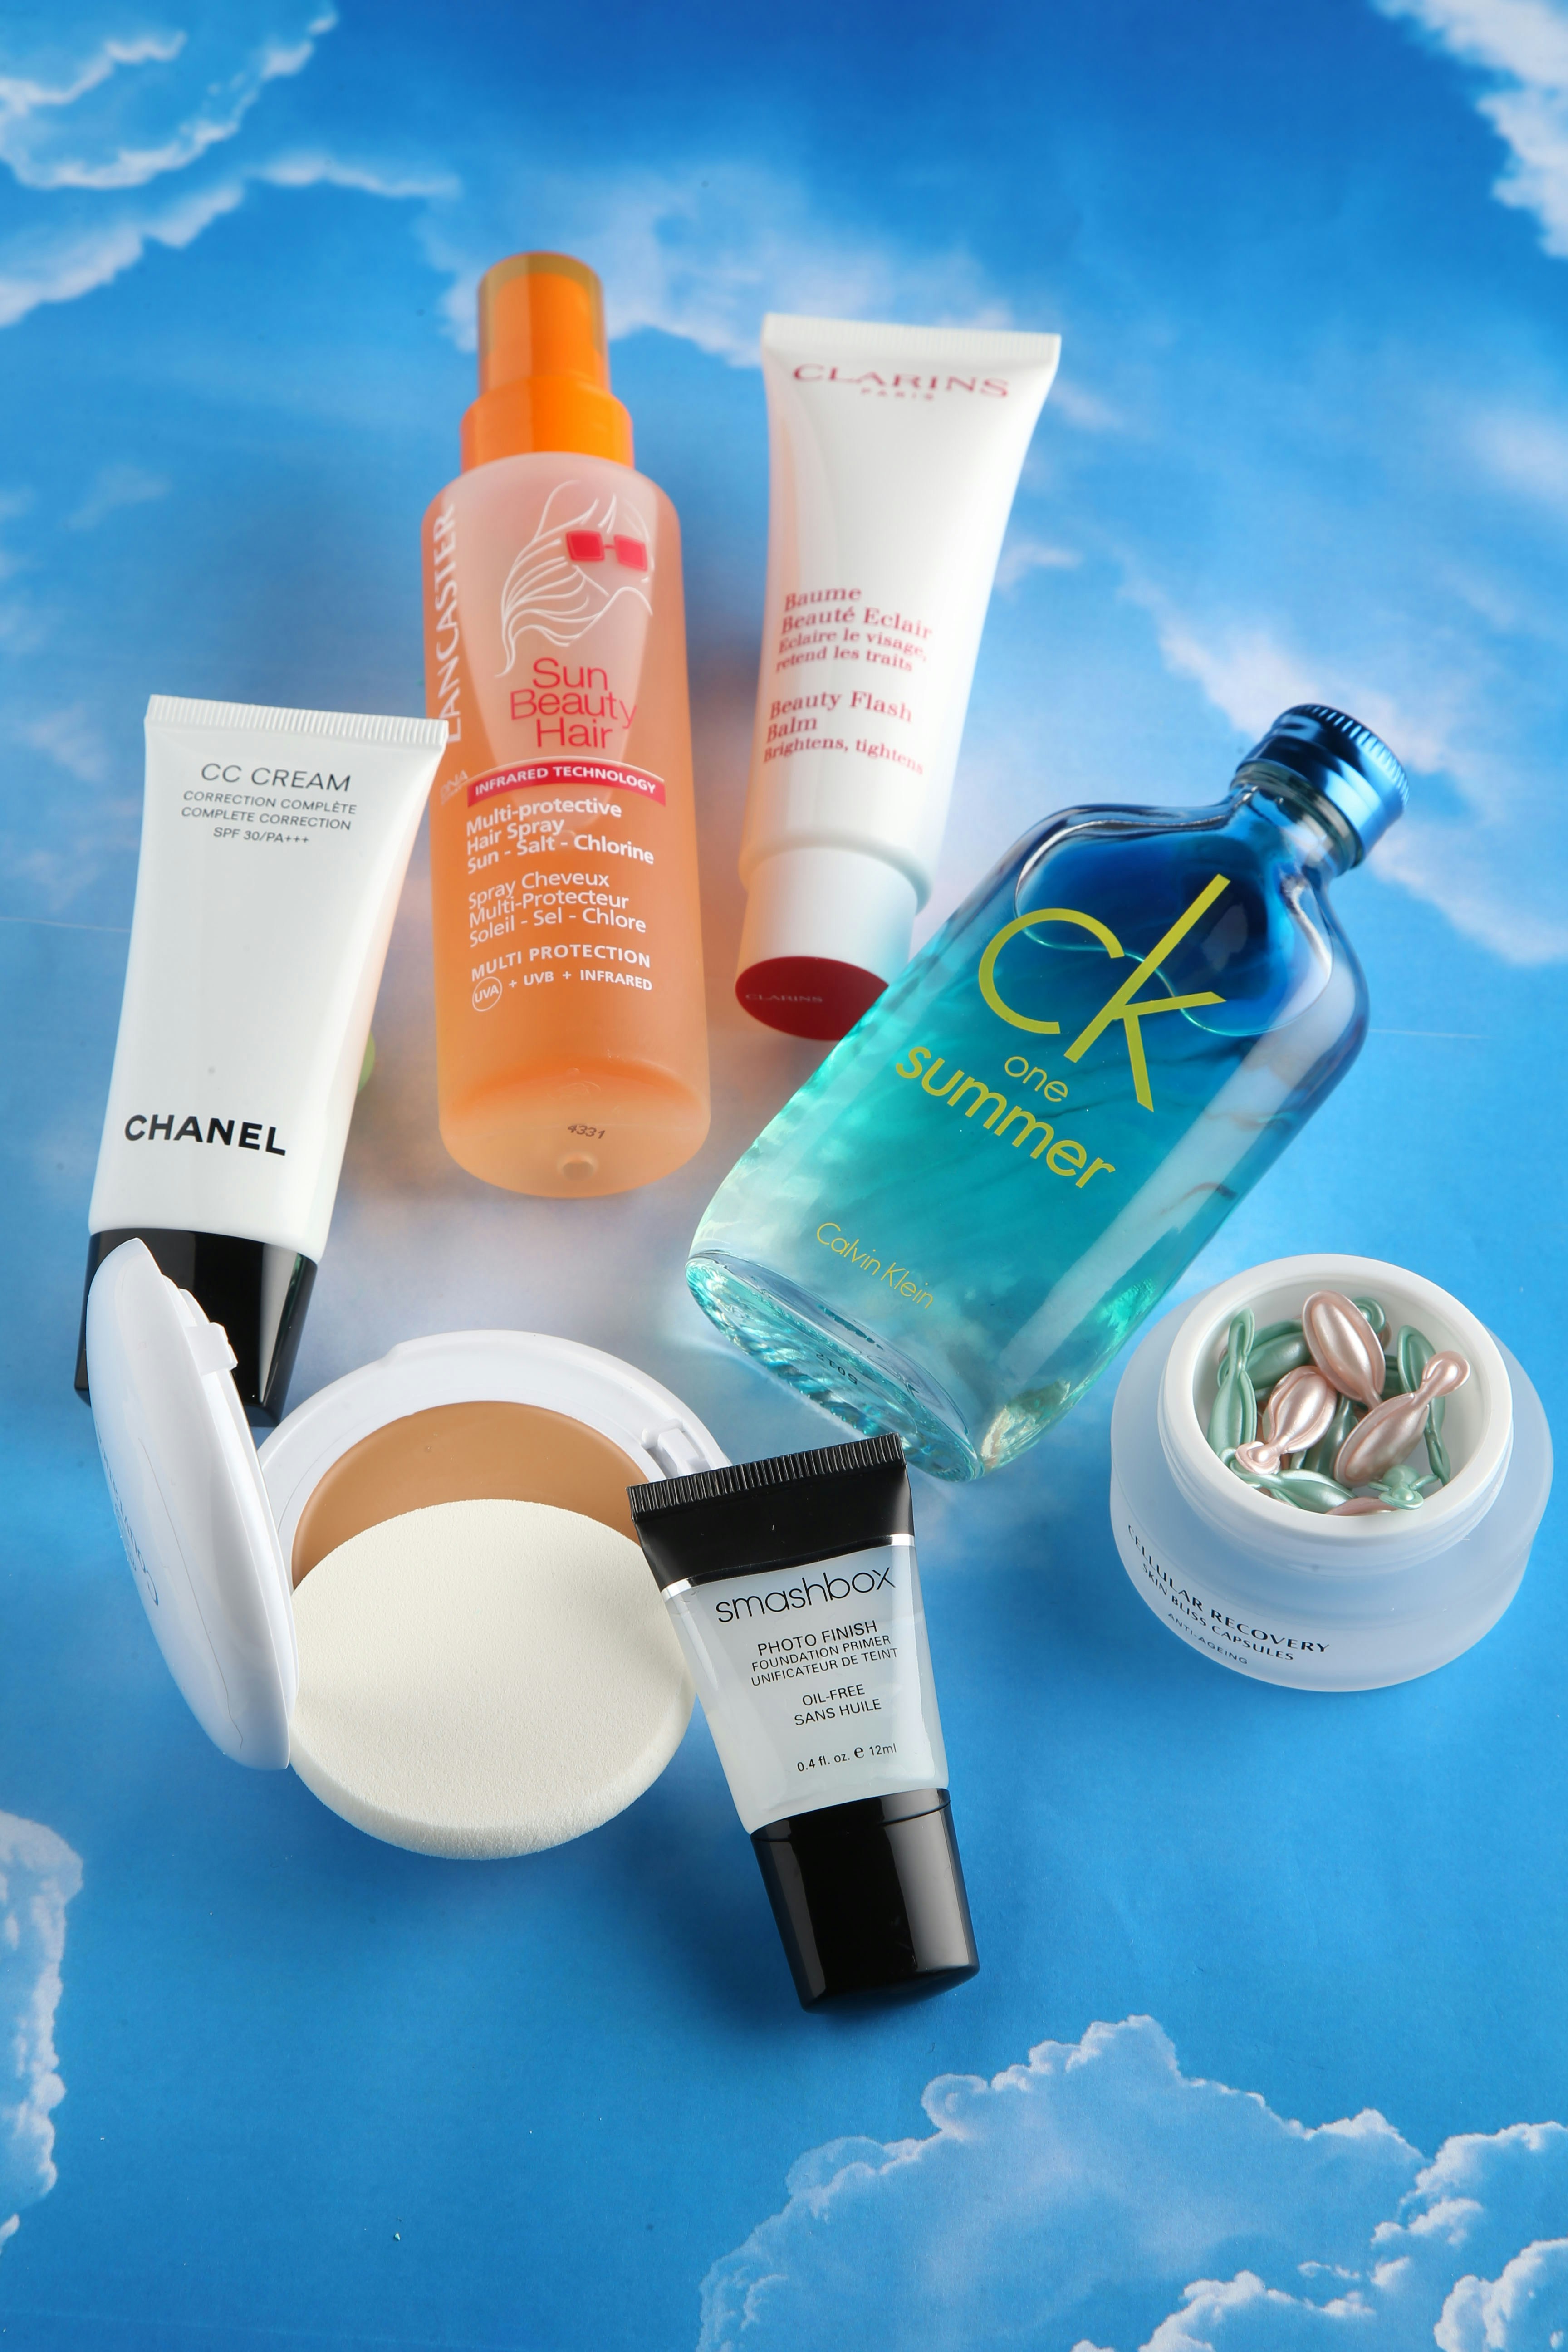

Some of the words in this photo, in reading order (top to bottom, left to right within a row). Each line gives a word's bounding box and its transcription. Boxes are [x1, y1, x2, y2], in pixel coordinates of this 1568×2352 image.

[793, 364, 1010, 399] CLARINS
[860, 387, 935, 400] PARIS
[784, 588, 862, 612] Baume
[433, 503, 462, 744] LANCASTER
[781, 606, 855, 634] Beauté
[863, 606, 932, 639] Eclair
[843, 627, 860, 641] le
[532, 657, 608, 691] Sun
[775, 646, 827, 673] retend
[833, 645, 860, 659] les
[866, 649, 913, 672] traits
[510, 688, 637, 729] Beauty
[769, 691, 842, 720] Beauty
[850, 690, 912, 723] Flash
[536, 717, 612, 749] Hair
[767, 716, 817, 744] Balm
[764, 737, 848, 763] Brightens,
[856, 739, 924, 775] tightens
[201, 763, 242, 783] CC
[250, 767, 351, 792] CREAM
[475, 768, 549, 796] INFRARED
[553, 766, 656, 794] TECHNOLOGY
[181, 806, 255, 823] COMPLETE
[259, 813, 352, 831] CORRECTION
[183, 790, 276, 808] CORRECTION
[280, 799, 358, 815] COMPLÈTE
[466, 797, 622, 837] Multi-protective
[213, 827, 240, 839] SPF
[243, 830, 310, 844] 30/PA+++
[467, 829, 502, 856] Hair
[506, 818, 565, 840] Spray
[467, 850, 499, 875] Sun
[516, 835, 555, 856] Salt
[573, 834, 654, 865] Chlorine
[468, 880, 516, 909] Spray
[521, 871, 610, 889] Cheveux
[469, 890, 630, 929] Multi-Protecteur
[470, 914, 515, 948] Soleil
[534, 907, 562, 926] Sel
[582, 907, 647, 933] Chlore
[471, 951, 522, 982] MULTI
[529, 944, 651, 968] PROTECTION
[474, 984, 500, 1004] UVA
[524, 971, 554, 986] UVB
[580, 969, 652, 991] INFRARED
[745, 994, 823, 1003] CLARINS
[1004, 1055, 1069, 1102] one
[124, 1113, 287, 1156] CHANEL
[567, 1124, 606, 1139] 4331
[895, 1046, 1116, 1189] summer
[816, 1221, 881, 1277] Calvin
[881, 1262, 934, 1310] Klein
[715, 1566, 897, 1623] smashbox
[1128, 1524, 1203, 1612] CELLULAR
[1210, 1608, 1330, 1653] RECOVERY
[1142, 1563, 1168, 1597] SKIN
[1171, 1595, 1207, 1627] BLISS
[1211, 1625, 1294, 1661] CAPSULES
[751, 1645, 840, 1672] FOUNDATION
[843, 1635, 891, 1655] PRIMER
[757, 1633, 818, 1656] PHOTO
[821, 1620, 878, 1644] FINISH
[1167, 1612, 1248, 1665] ANTI-AGEING
[751, 1659, 838, 1686] UNIFICATEUR
[841, 1655, 859, 1667] DE
[860, 1647, 898, 1663] TEINT
[794, 1707, 836, 1726] SANS
[838, 1698, 882, 1717] HUILE
[802, 1684, 866, 1707] OIL-FREE
[797, 1759, 816, 1772] 0.4
[818, 1755, 831, 1766] fl.
[833, 1753, 850, 1763] oz.
[869, 1742, 897, 1756] 12ml
